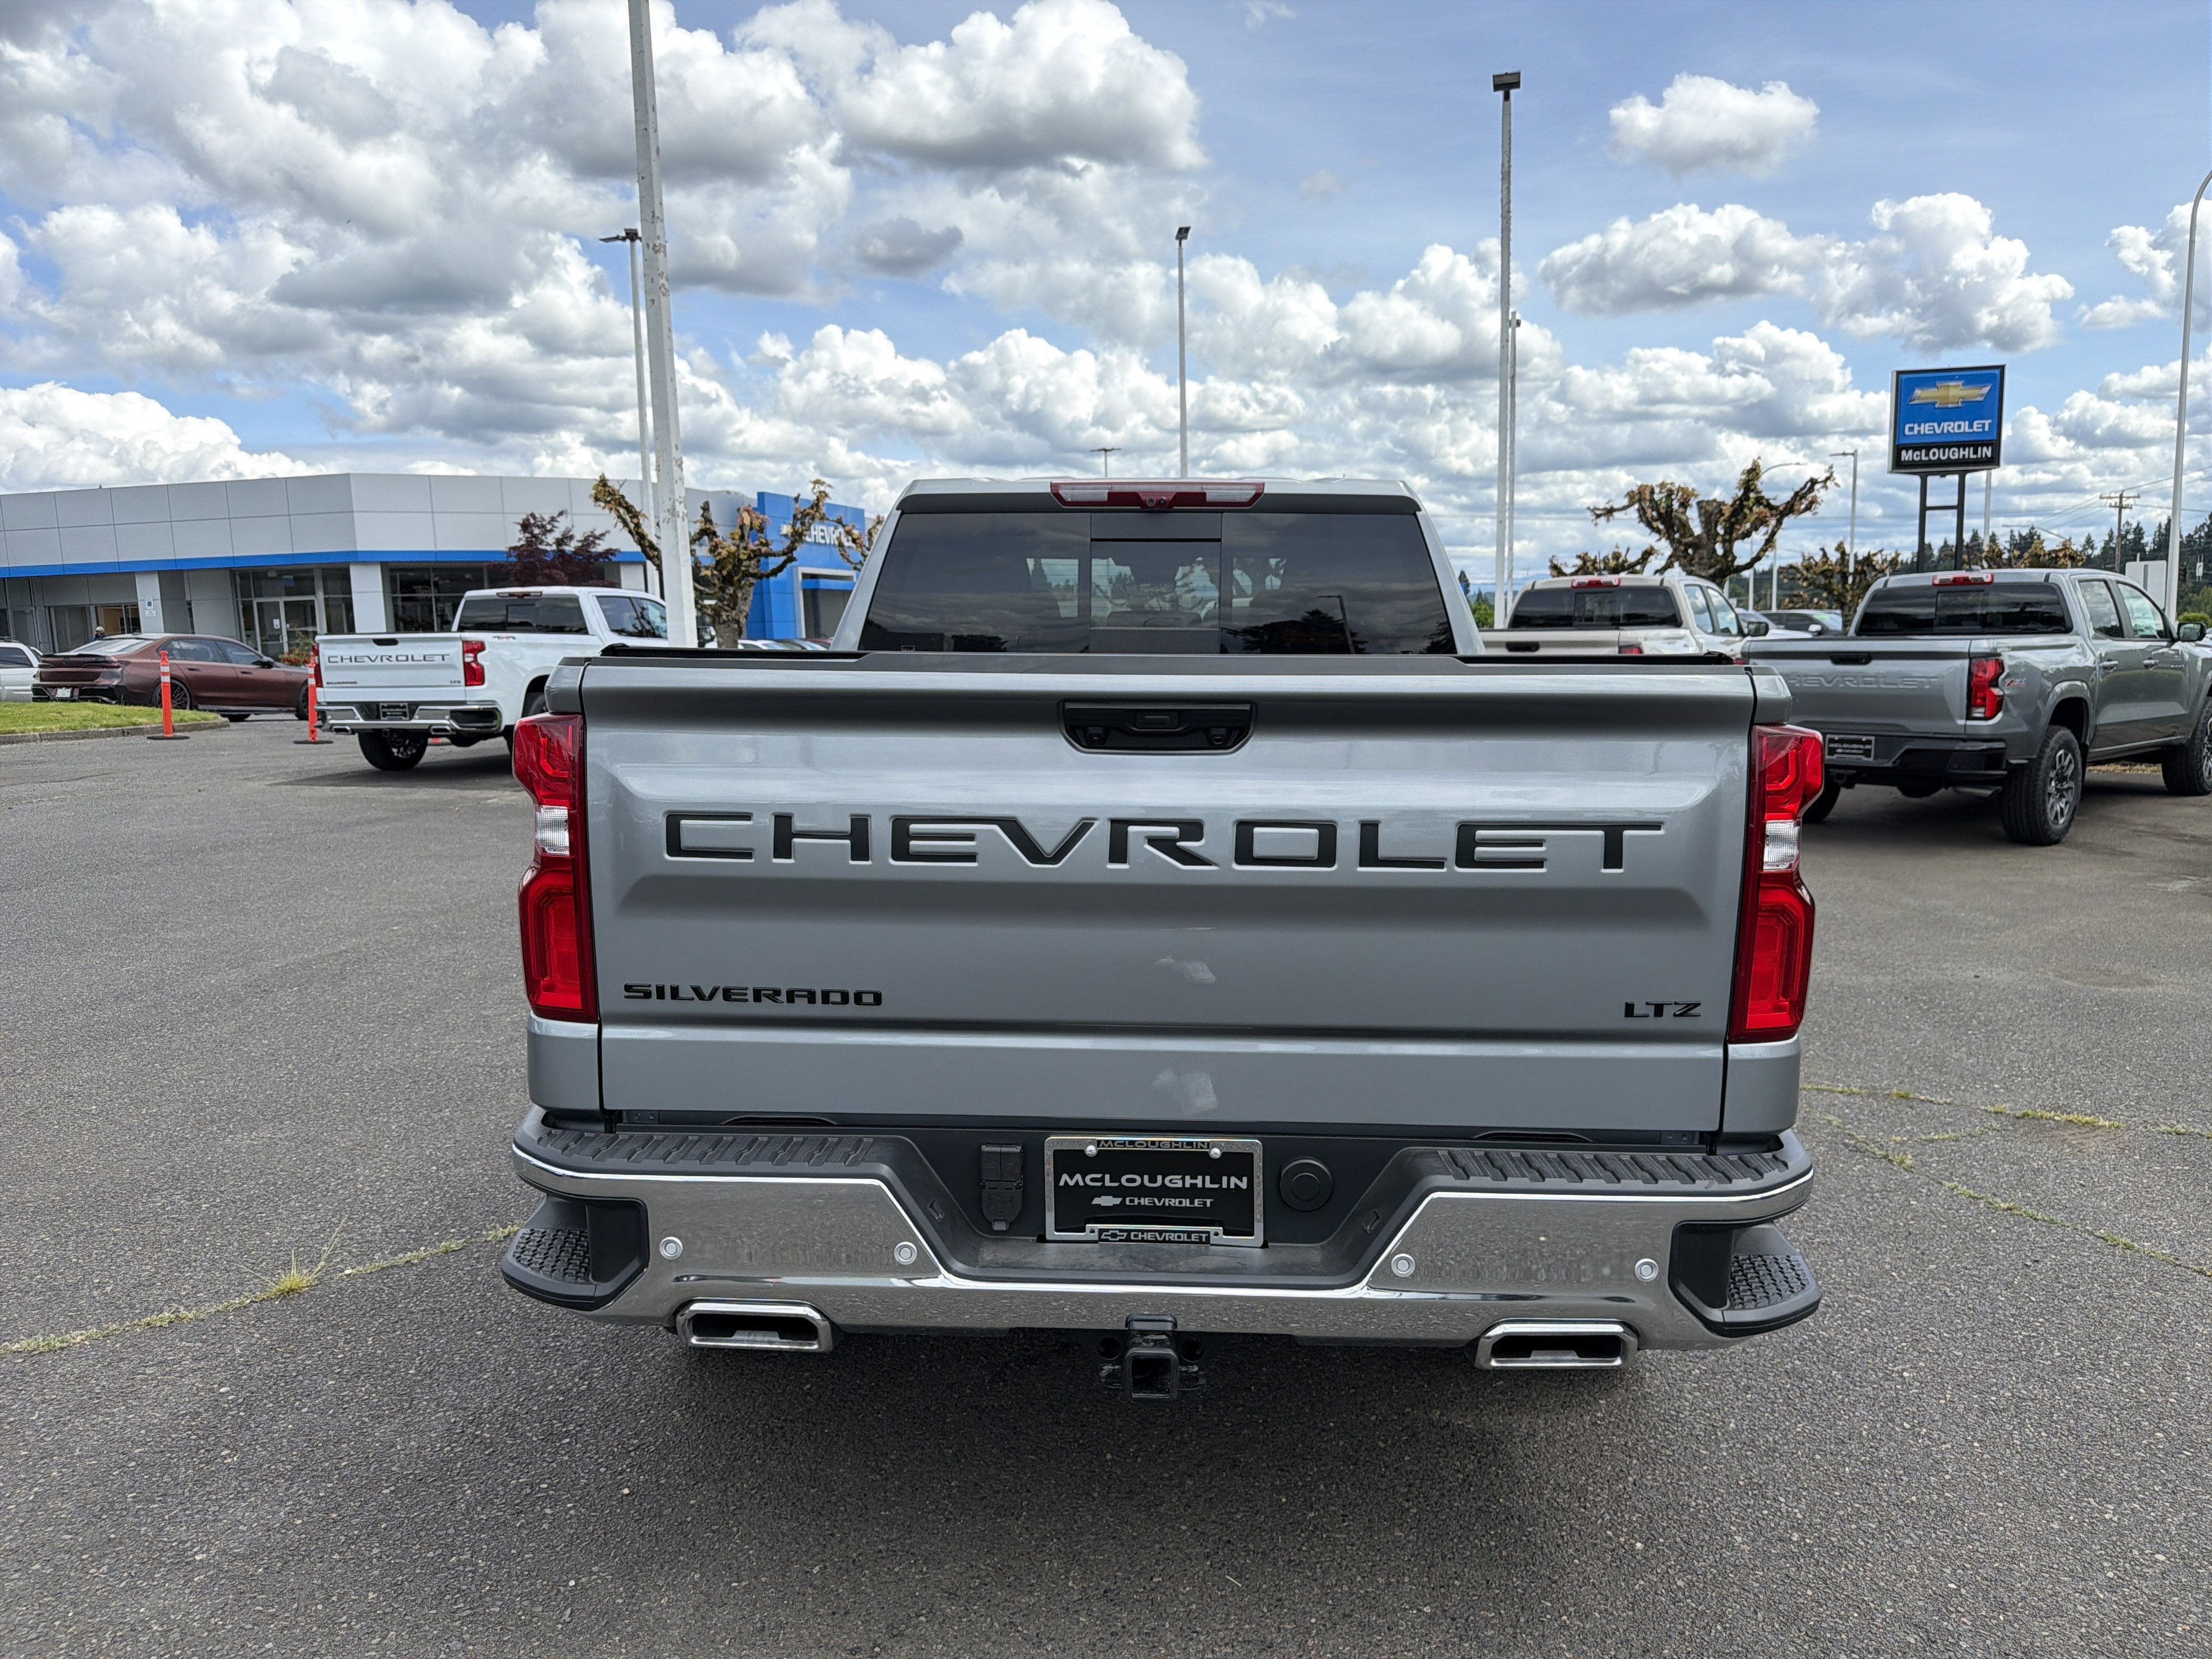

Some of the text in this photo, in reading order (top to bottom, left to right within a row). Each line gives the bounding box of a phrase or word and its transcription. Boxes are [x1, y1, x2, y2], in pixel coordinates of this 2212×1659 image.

[1904, 419, 1992, 436] CHEVROLET
[1901, 445, 1992, 461] McLOUGHLIN
[328, 653, 450, 664] CHEVROLET
[664, 812, 1664, 872] CHEVROLET
[624, 983, 882, 1006] SILVERADO
[1624, 1001, 1701, 1017] LTZ
[1099, 1140, 1207, 1149] MCLOUGHLIN
[1059, 1173, 1248, 1189] MCLOUGHLIN
[1126, 1197, 1214, 1207] CHEVROLET
[1130, 1231, 1208, 1242] CHEVROLET
